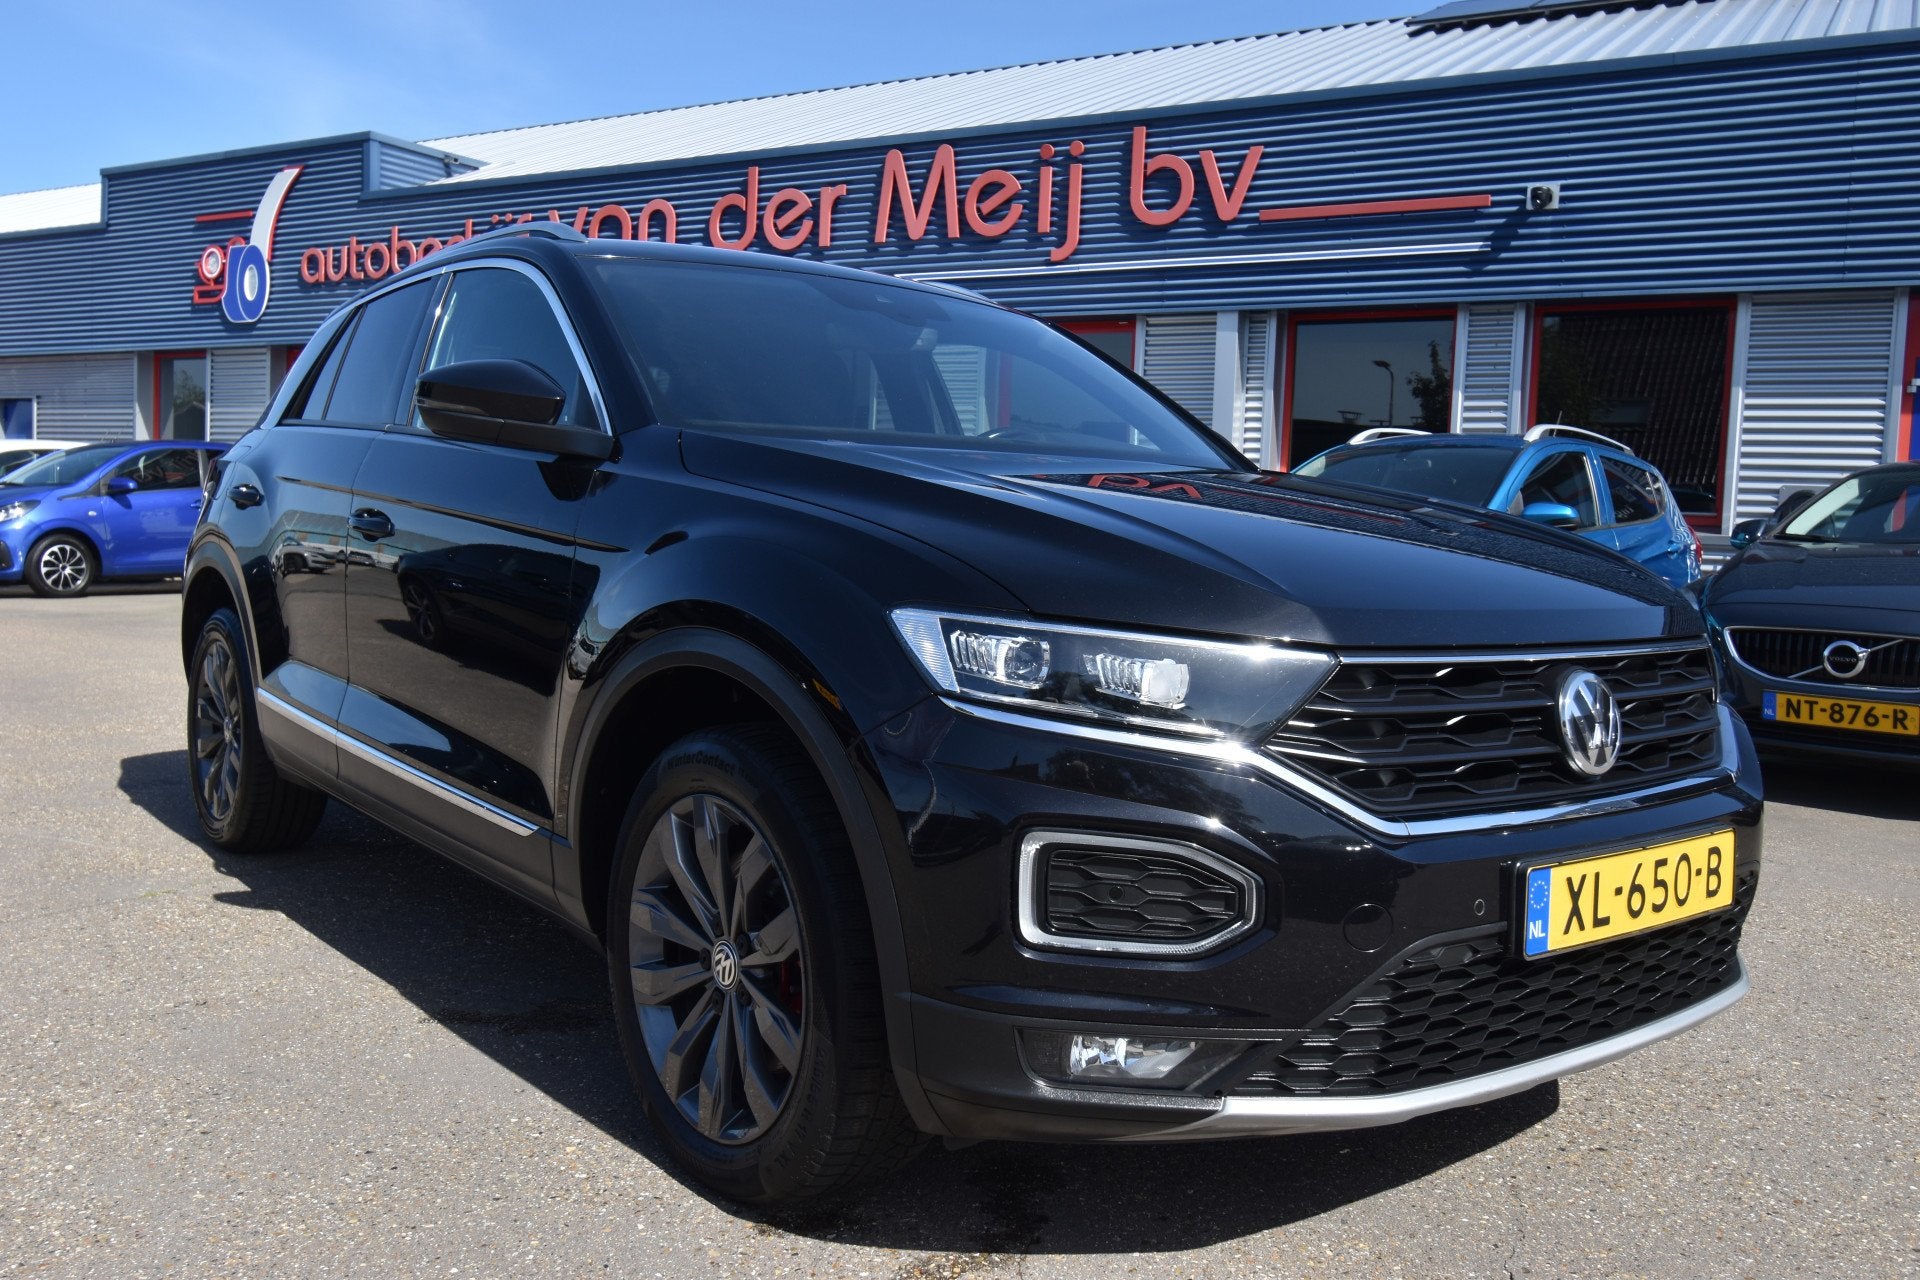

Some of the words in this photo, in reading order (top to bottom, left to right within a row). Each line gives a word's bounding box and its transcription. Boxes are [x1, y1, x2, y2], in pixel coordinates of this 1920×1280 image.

[709, 166, 847, 250] der
[874, 140, 1085, 261] Meij
[1129, 126, 1264, 226] bv
[1764, 708, 1774, 716] NL
[1785, 698, 1908, 730] NT-876-R
[1563, 846, 1722, 935] XL-650-B
[1529, 920, 1545, 939] NL
